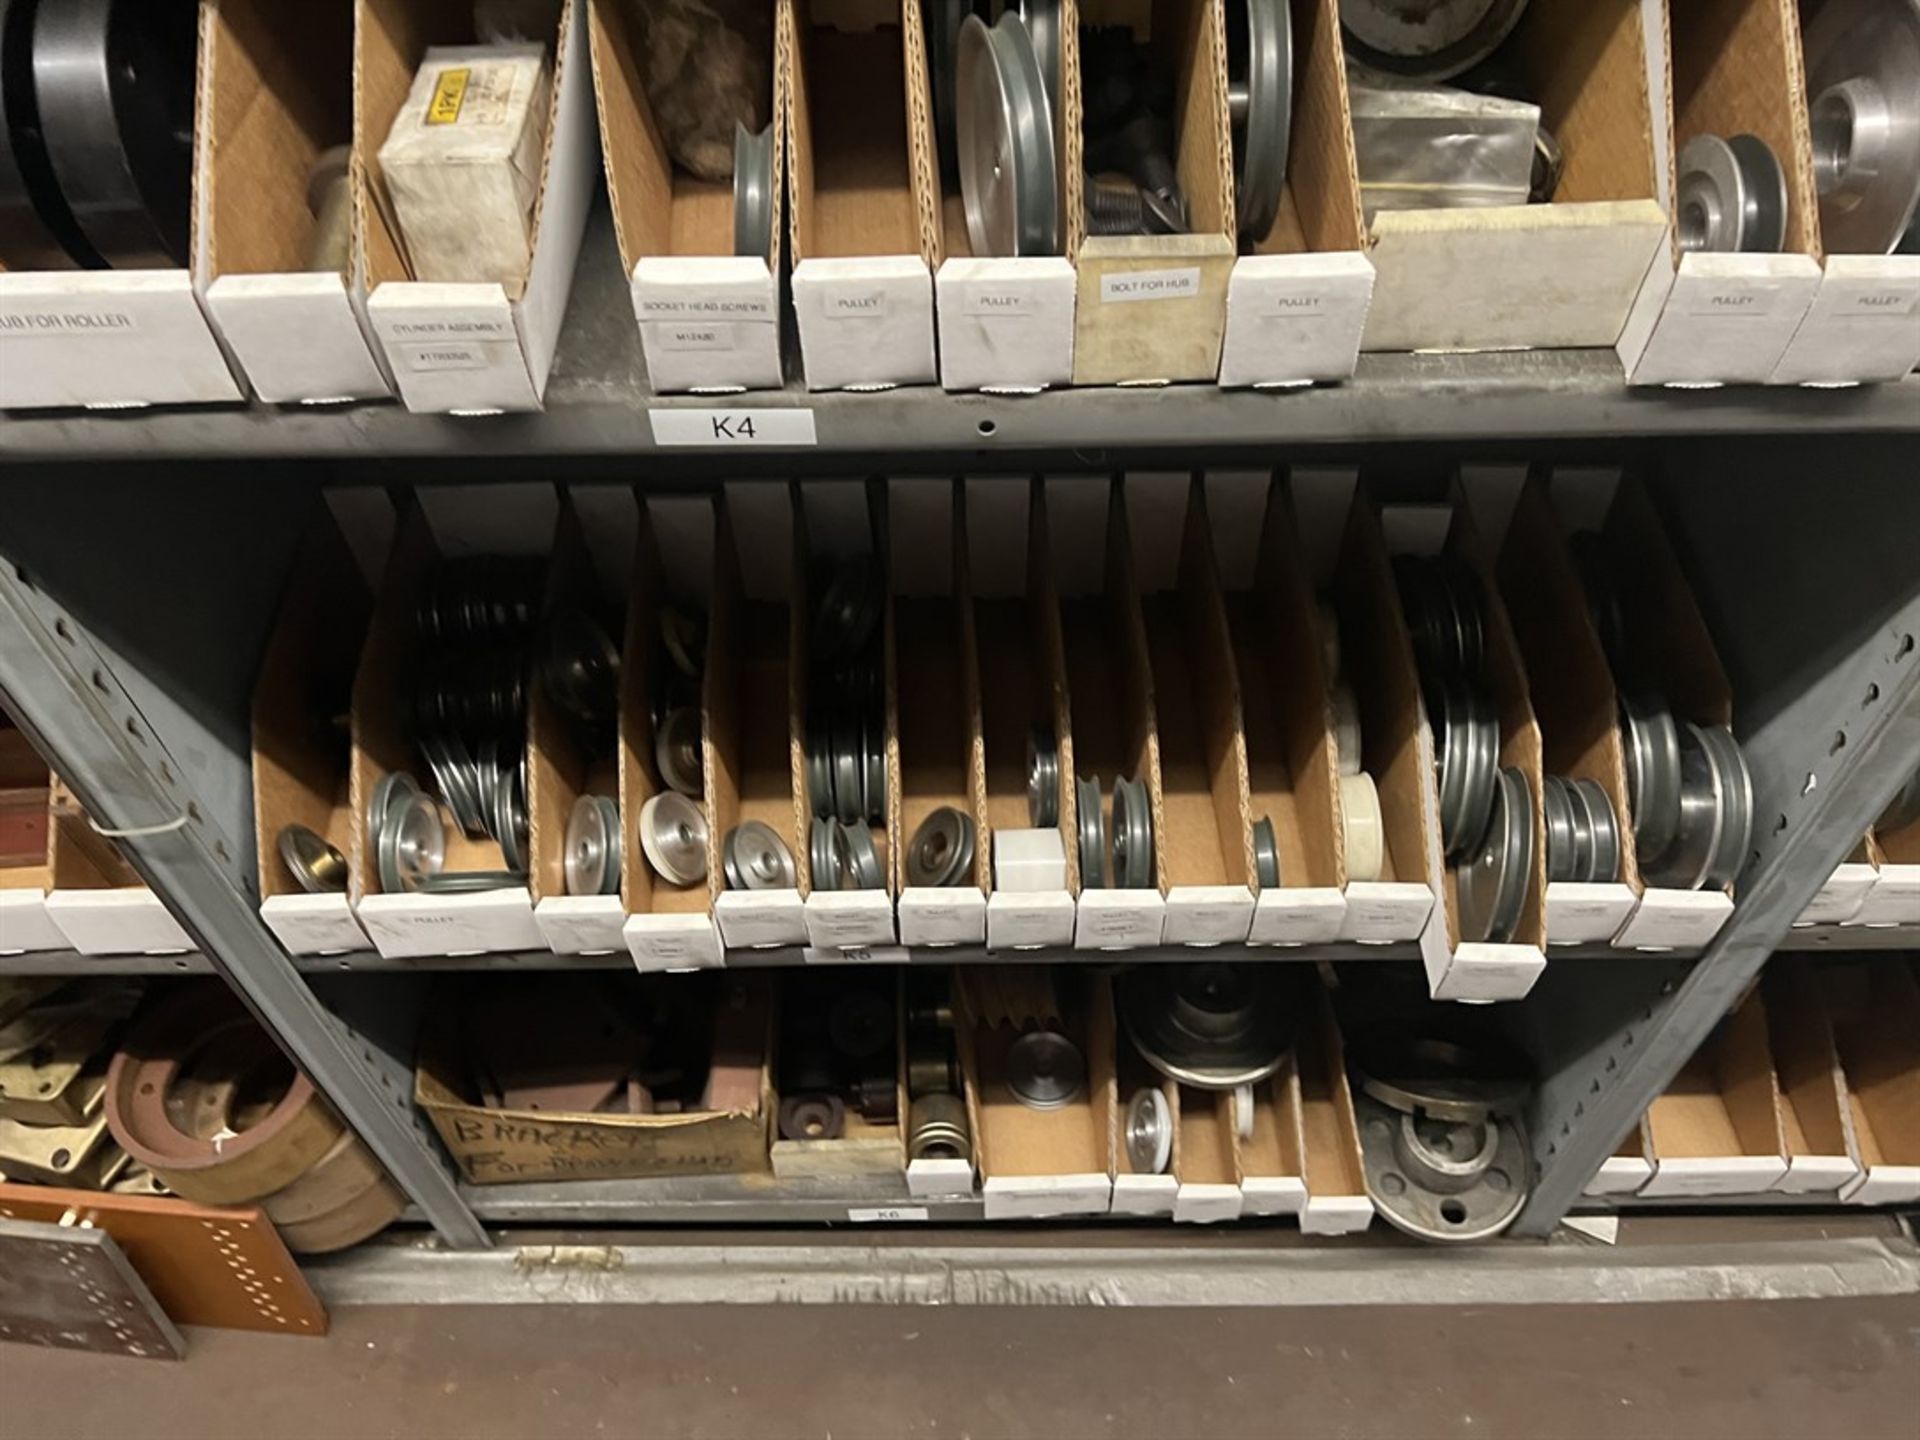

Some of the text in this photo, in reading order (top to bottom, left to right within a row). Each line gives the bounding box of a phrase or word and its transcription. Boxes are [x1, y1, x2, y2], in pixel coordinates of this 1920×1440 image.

[1110, 276, 1190, 294] BOLT FOR HUB
[838, 298, 879, 309] PULLEY
[980, 296, 1021, 307] PULLEY
[1279, 297, 1320, 308] PULLEY
[1711, 296, 1754, 306] PULLEY
[1858, 296, 1902, 306] PULLEY
[643, 301, 767, 313] SOCKET HEAD SCREWS
[25, 314, 62, 328] FOR
[63, 313, 131, 328] ROLLER
[392, 323, 503, 335] CYLINDER ASSEMBLY
[712, 415, 757, 439] K4
